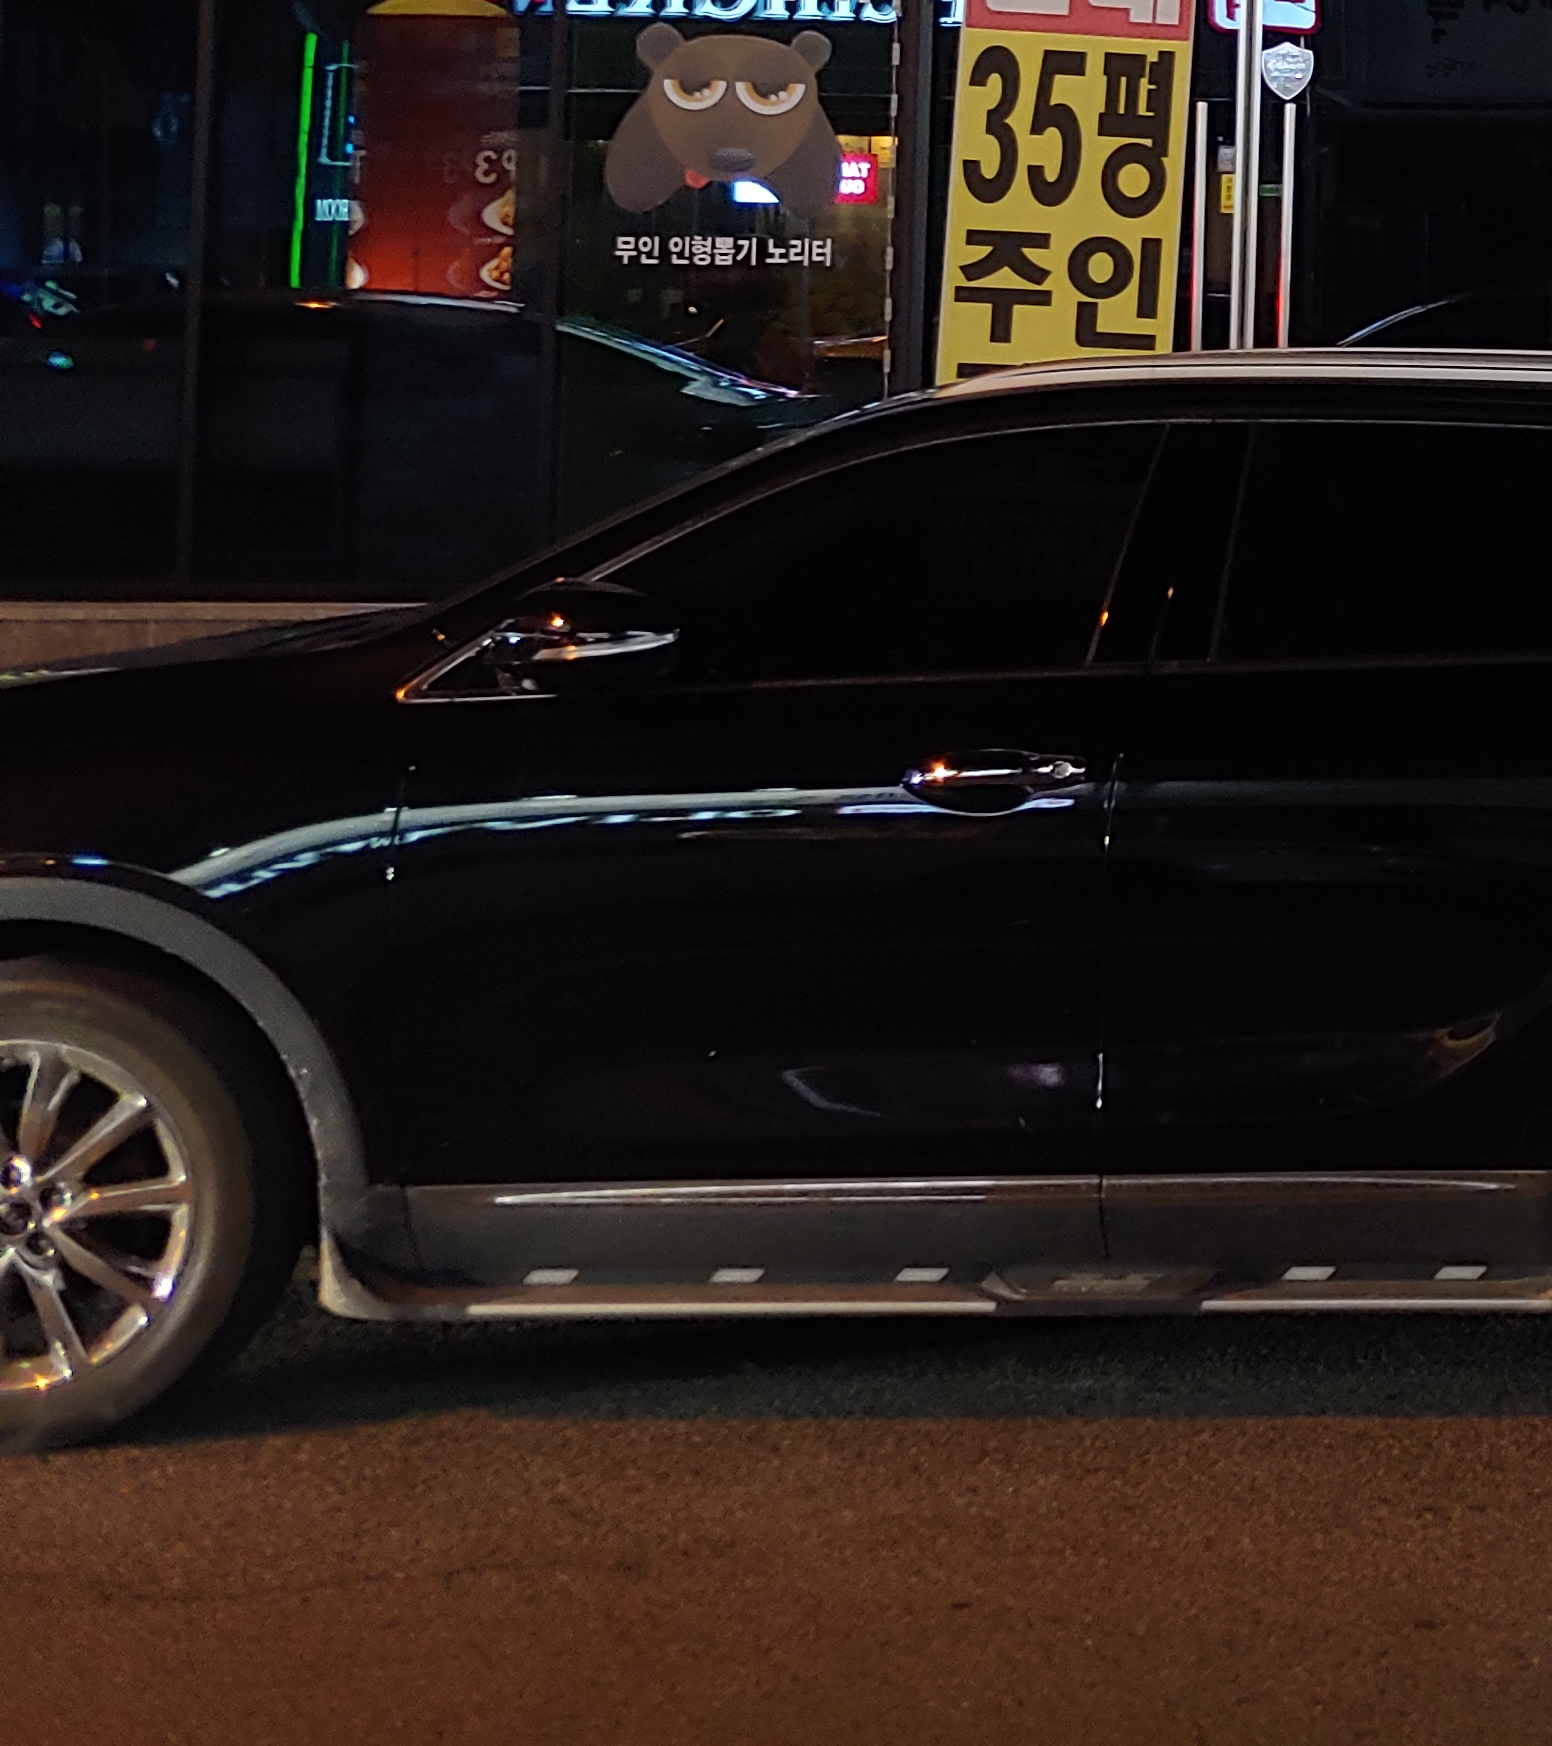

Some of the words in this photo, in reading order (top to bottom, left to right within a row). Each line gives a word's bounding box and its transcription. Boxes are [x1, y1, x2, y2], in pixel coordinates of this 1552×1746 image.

[961, 44, 1178, 219] 35평
[614, 235, 660, 265] 무인
[668, 235, 757, 266] 인형뽑기
[765, 237, 832, 267] 노리터
[953, 229, 1161, 353] 주인
